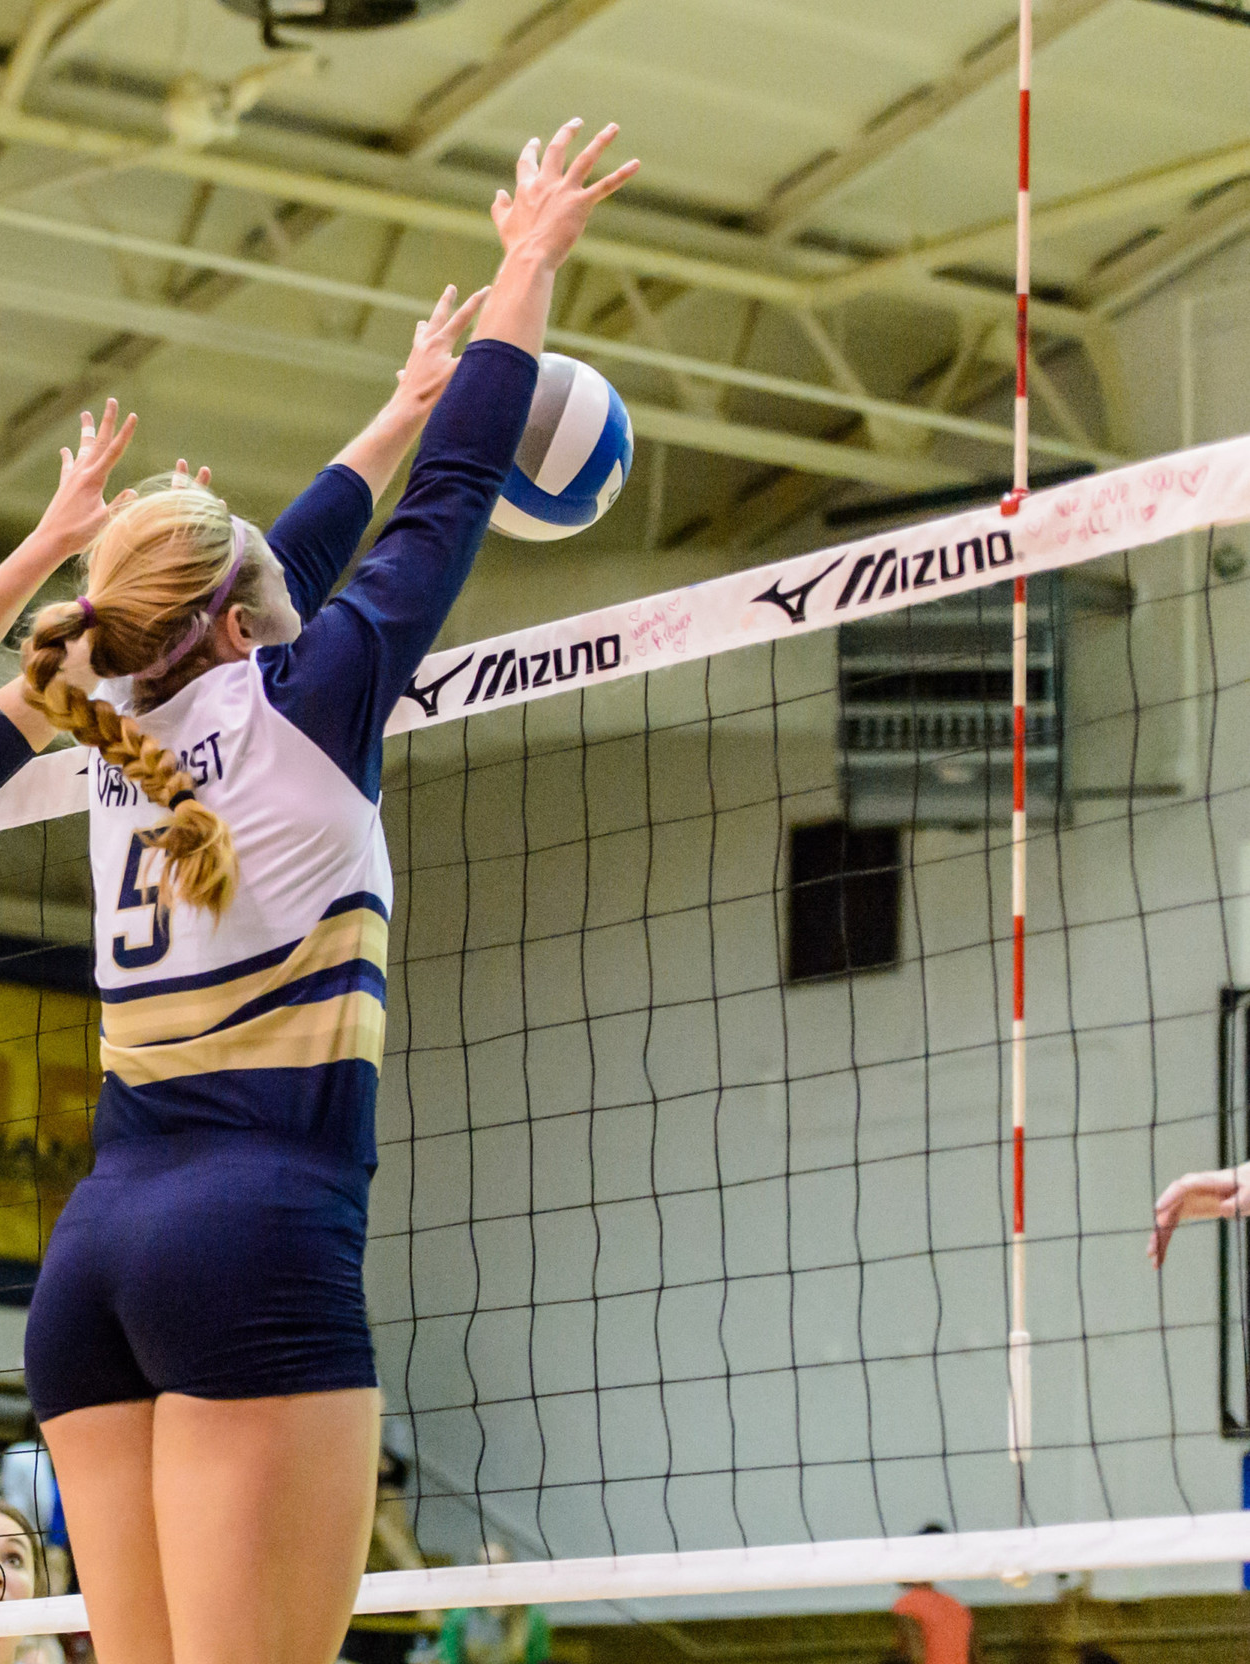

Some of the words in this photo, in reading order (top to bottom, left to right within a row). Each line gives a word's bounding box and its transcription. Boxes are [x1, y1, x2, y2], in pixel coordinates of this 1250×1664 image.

[834, 530, 1014, 610] MIZUNO
[463, 634, 620, 706] MIZUNO
[112, 827, 174, 970] 5
